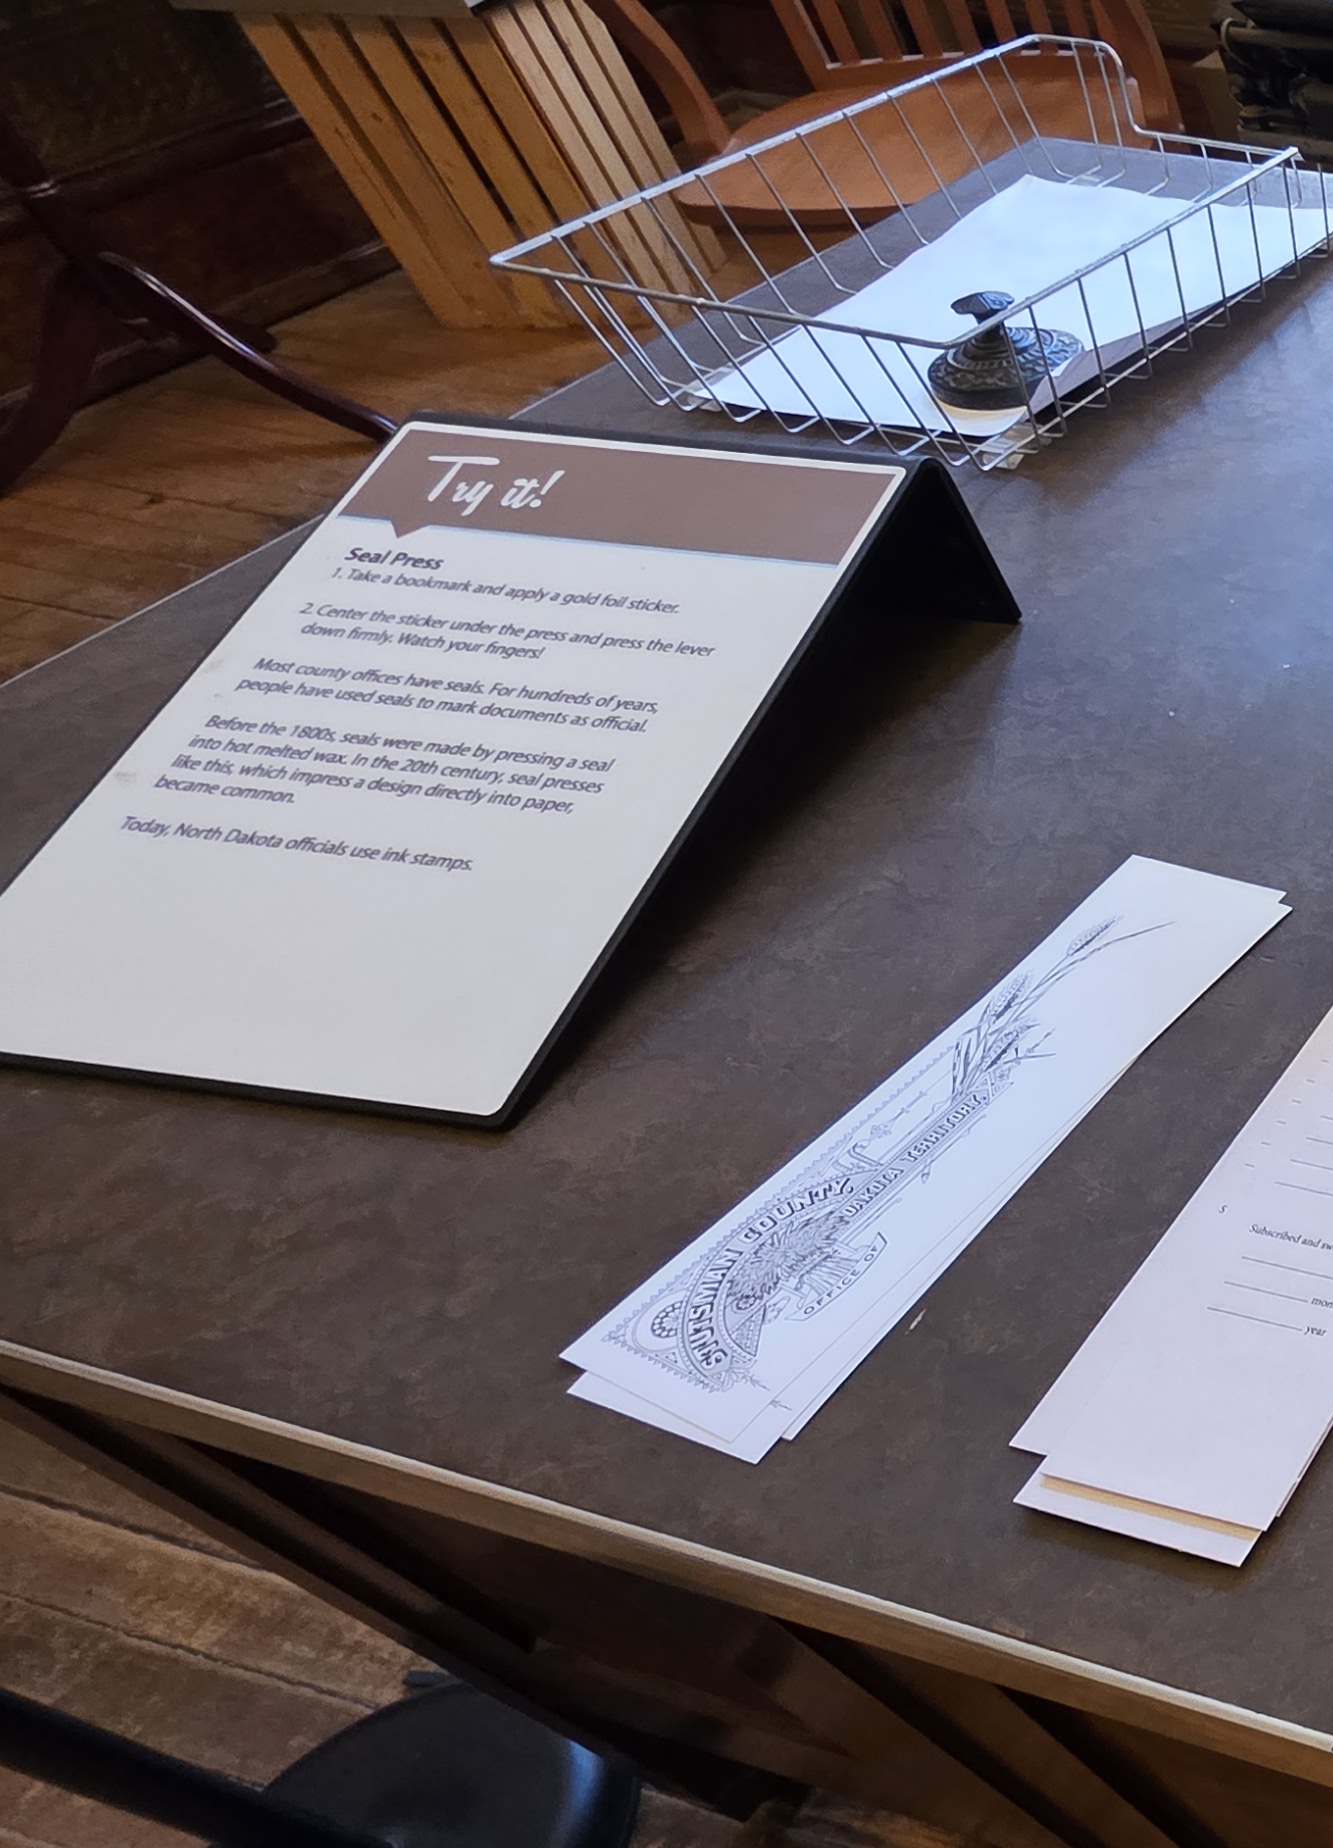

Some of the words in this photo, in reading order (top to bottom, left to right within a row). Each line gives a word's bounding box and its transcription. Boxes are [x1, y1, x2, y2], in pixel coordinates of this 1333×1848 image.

[428, 456, 500, 516] Try
[500, 470, 565, 508] it!
[344, 548, 392, 565] Seal
[390, 552, 444, 570] Press
[332, 567, 343, 579] 1.
[347, 568, 381, 583] Take
[381, 574, 393, 584] a
[394, 573, 472, 592] bookmark
[472, 582, 507, 596] and
[504, 587, 550, 603] apply
[549, 592, 561, 602] a
[560, 592, 602, 606] gold
[600, 594, 629, 608] foil
[627, 599, 680, 614] sticker.
[301, 622, 346, 638] down
[346, 626, 394, 646] firmly.
[397, 632, 446, 649] Watch
[443, 639, 486, 653] your
[484, 641, 546, 660] fingers!
[316, 604, 369, 621] Center
[369, 610, 397, 624] the
[395, 614, 449, 629] sticker
[449, 620, 498, 635] under
[498, 623, 526, 638] the
[523, 629, 568, 642] press
[567, 632, 604, 646] and
[600, 635, 645, 650] press
[646, 638, 674, 654] the
[674, 641, 716, 657] lever
[234, 679, 294, 695] people
[293, 682, 334, 699] have
[334, 689, 378, 704] used
[374, 693, 415, 708] seals
[415, 696, 435, 710] to
[434, 699, 480, 714] mark
[478, 703, 570, 725] documents
[569, 715, 588, 728] as
[590, 715, 649, 733] official.
[252, 657, 296, 674] Most
[295, 665, 352, 682] county
[351, 668, 404, 685] offices
[403, 673, 443, 690] have
[488, 681, 518, 698] For
[516, 685, 594, 706] hundreds
[594, 694, 617, 708] of
[611, 698, 659, 715] years,
[187, 734, 222, 750] into
[221, 738, 254, 754] hot
[252, 743, 316, 761] melted
[350, 752, 370, 767] In
[369, 755, 400, 771] the
[399, 758, 440, 775] 20th
[439, 763, 506, 786] century,
[506, 772, 545, 787] seal
[540, 775, 606, 794] presses
[204, 714, 259, 733] Before
[258, 721, 287, 736] the
[289, 724, 337, 743] 1800s,
[338, 731, 382, 747] seals
[382, 737, 423, 752] were
[422, 741, 473, 757] made
[471, 743, 496, 761] by
[492, 749, 566, 771] pressing
[567, 758, 579, 769] a
[577, 757, 617, 773] seal
[154, 774, 220, 795] became
[220, 785, 296, 804] common.
[170, 753, 202, 771] like
[202, 758, 235, 776] this,
[239, 763, 289, 781] which
[289, 768, 352, 788] impress
[352, 778, 363, 789] a
[366, 777, 423, 798] design
[423, 783, 489, 806] directly
[486, 790, 523, 807] into
[519, 797, 575, 815] paper,
[120, 815, 172, 838] Today,
[172, 822, 224, 841] North
[223, 828, 284, 849] Dakota
[284, 836, 350, 857] officials
[349, 846, 381, 861] use
[380, 847, 411, 864] ink
[409, 852, 473, 872] stamps.
[843, 1167, 904, 1218] DAKOTA
[1250, 1223, 1302, 1244] Subscribed
[1301, 1238, 1321, 1249] and
[689, 1247, 743, 1367] STUTSMAN
[804, 1269, 858, 1315] OFFICE
[864, 1245, 879, 1262] OF
[1303, 1325, 1327, 1338] year
